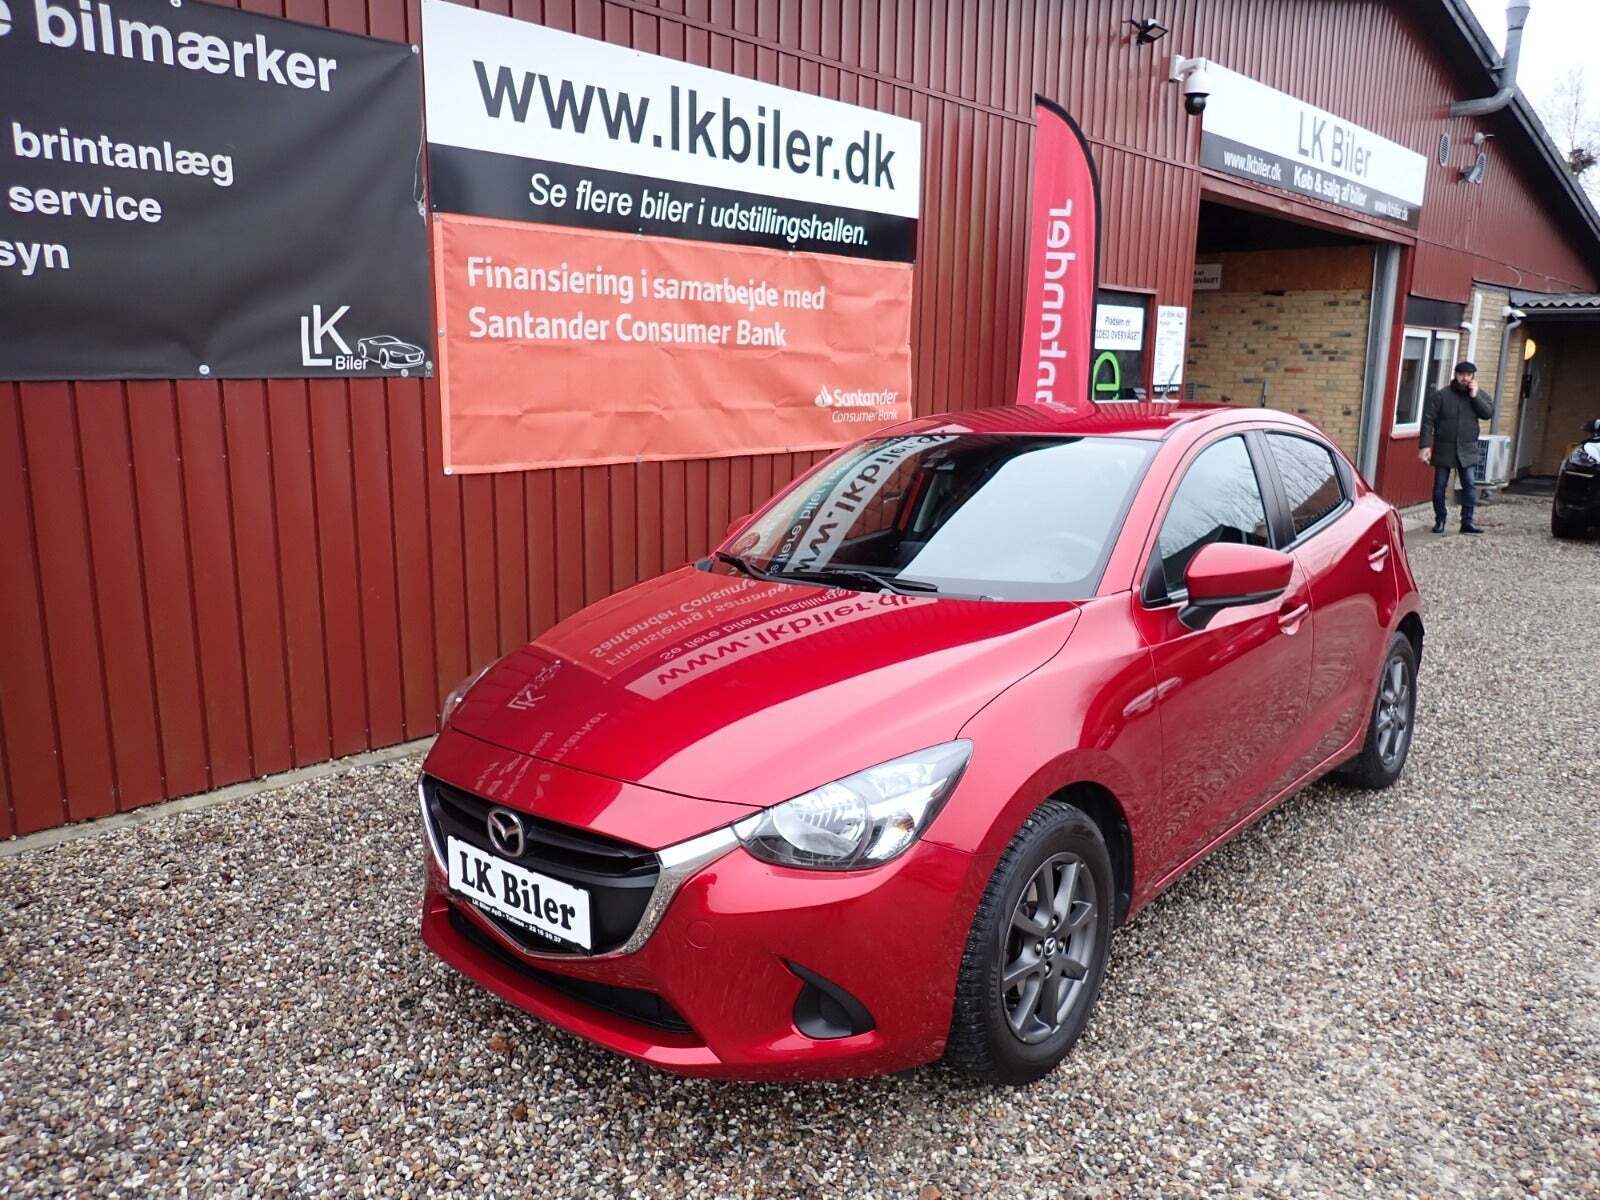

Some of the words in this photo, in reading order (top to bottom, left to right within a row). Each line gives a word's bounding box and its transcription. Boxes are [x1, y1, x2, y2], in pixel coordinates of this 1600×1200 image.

[35, 0, 337, 92] bilmærker
[12, 122, 234, 187] brintanlæg
[473, 60, 896, 190] www.lkbiler.dk
[1297, 111, 1326, 163] LK
[1331, 124, 1372, 179] Biler
[1223, 151, 1281, 182] www.lkbiler.dk
[1293, 166, 1314, 190] Køb
[1314, 173, 1322, 193] &
[1322, 177, 1340, 203] salg
[1339, 181, 1350, 202] af
[1349, 184, 1368, 207] biler
[9, 185, 162, 223] service
[529, 173, 567, 208] Se
[576, 181, 633, 216] flere
[640, 190, 692, 226] biler
[697, 198, 705, 226] i
[711, 202, 868, 247] udstillingshallen.
[467, 257, 634, 304] Finansiering
[640, 269, 649, 299] i
[653, 275, 778, 312] samarbejde
[783, 286, 826, 311] med
[301, 304, 353, 367] LK
[335, 355, 369, 371] Biler
[468, 307, 608, 342] Santander
[616, 314, 731, 345] Consumer
[736, 320, 787, 347] Bank
[832, 410, 876, 423] Consumer
[878, 408, 897, 421] Bank
[833, 389, 898, 407] Santander
[460, 851, 496, 898] LK
[501, 870, 576, 930] Biler
